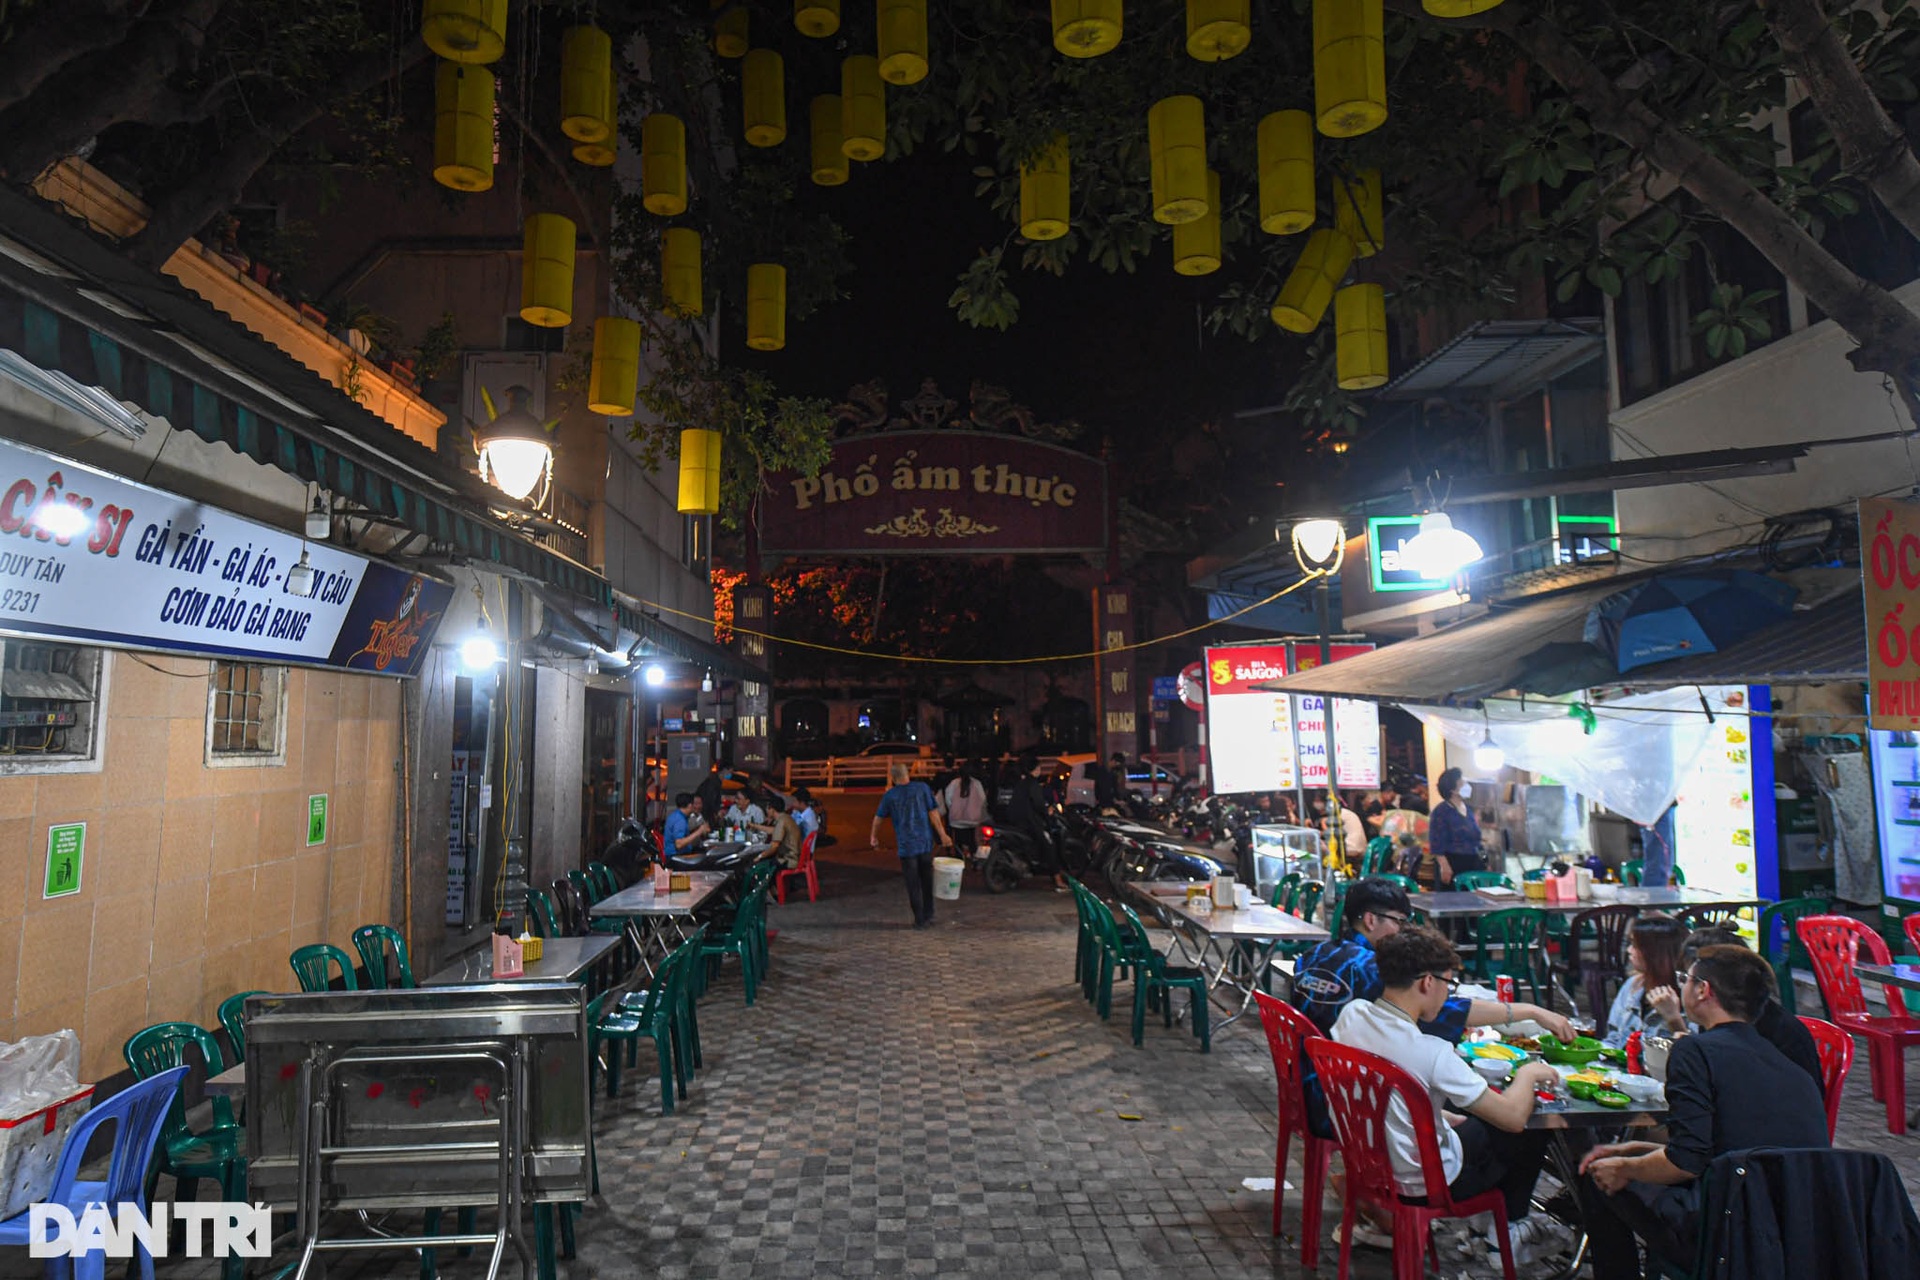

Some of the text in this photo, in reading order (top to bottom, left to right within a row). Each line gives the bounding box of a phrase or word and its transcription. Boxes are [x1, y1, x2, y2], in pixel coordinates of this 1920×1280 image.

[790, 450, 1077, 509] Phố ẩm thực
[88, 504, 134, 558] SI
[1871, 510, 1920, 591] ỐC
[32, 556, 65, 584] TÂN
[135, 520, 171, 566] GÀ
[221, 542, 252, 583] GÀ
[247, 548, 275, 588] ÁC
[321, 570, 353, 605] CÂU
[160, 587, 312, 641] CƠM ĐẢO GÀ RANG
[364, 620, 420, 670] Tiger
[1235, 665, 1283, 680] SAIGON
